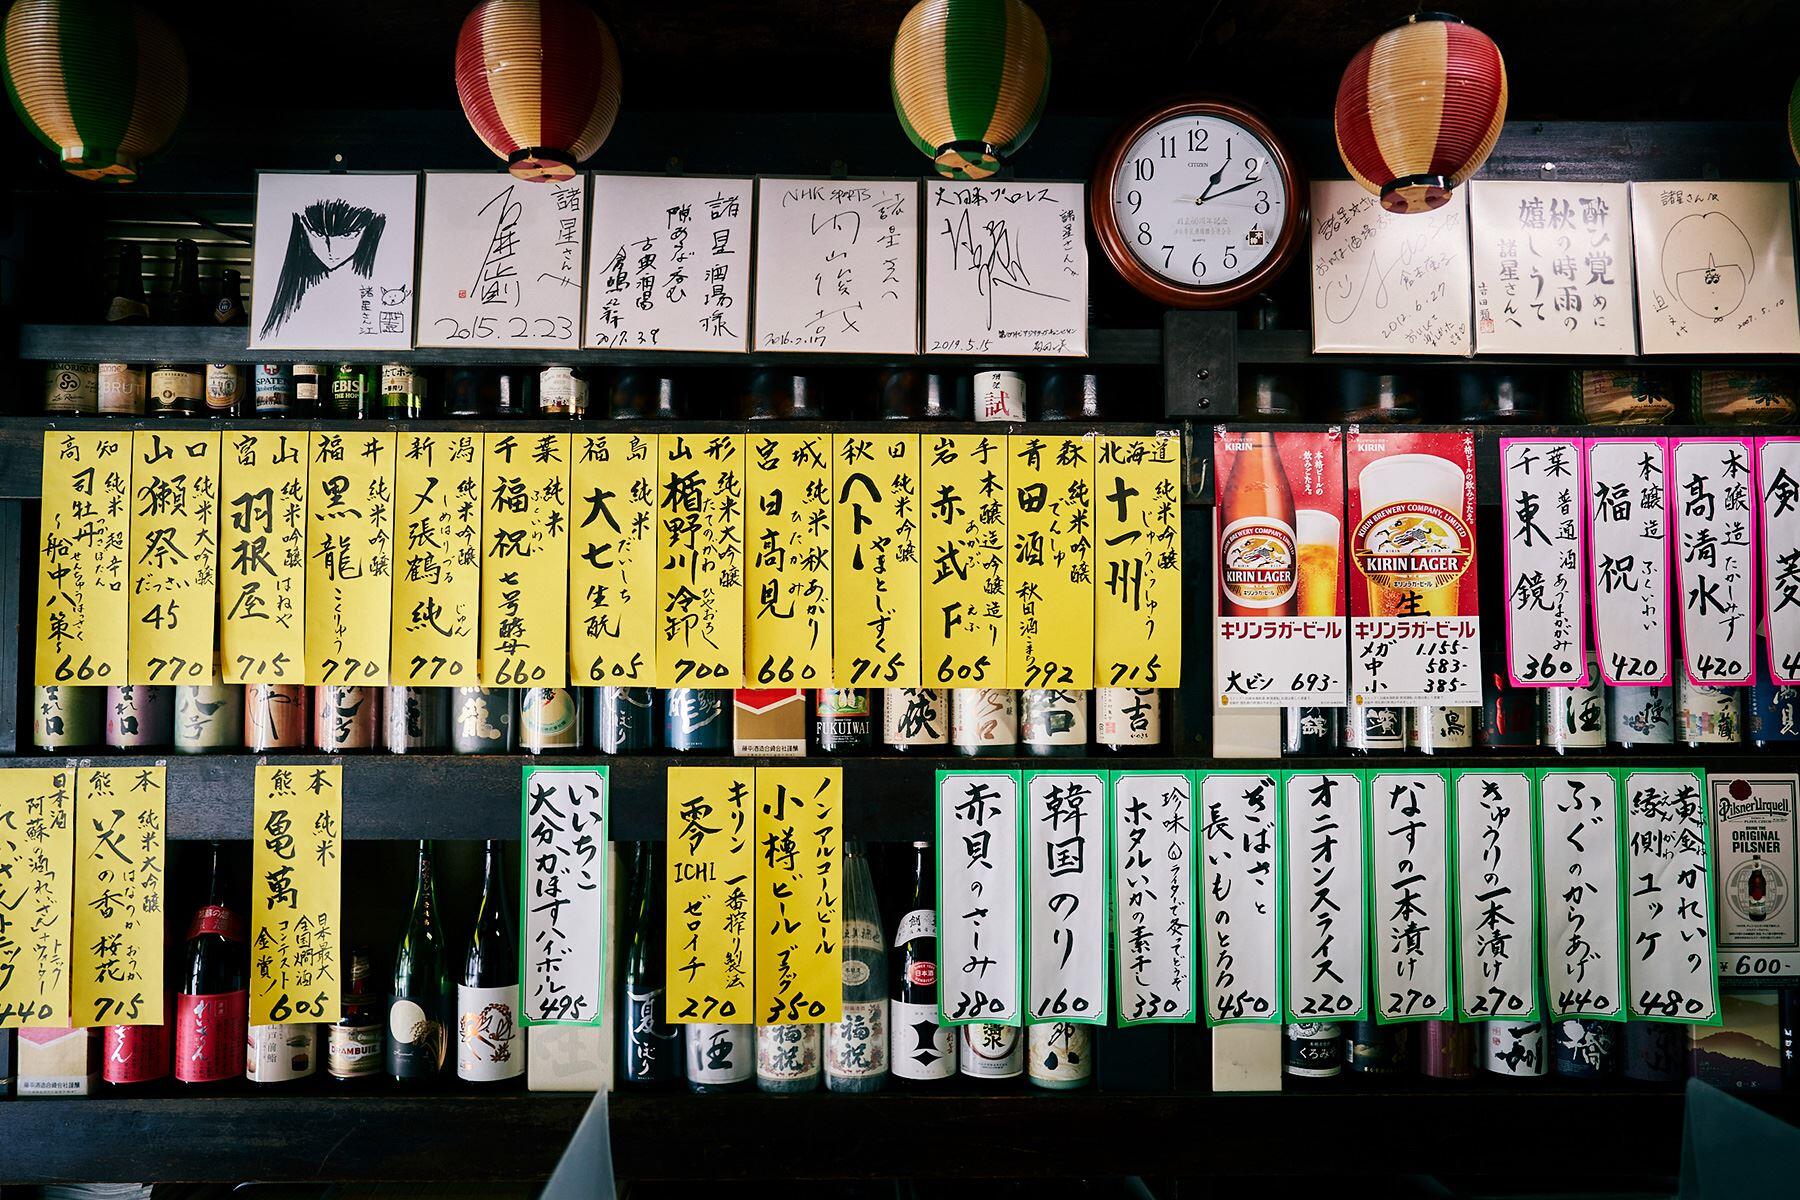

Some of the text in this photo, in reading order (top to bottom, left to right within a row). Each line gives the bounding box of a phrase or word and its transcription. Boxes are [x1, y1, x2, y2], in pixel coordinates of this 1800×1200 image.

[1160, 136, 1176, 158] 11
[1187, 128, 1209, 152] 12
[1226, 138, 1232, 160] 1
[1134, 158, 1154, 181] 10
[1245, 158, 1258, 181] 2
[1128, 190, 1142, 215] 9
[1255, 191, 1270, 214] 3
[1137, 222, 1152, 245] 8
[1161, 245, 1174, 268] 7
[1192, 253, 1206, 277] 6
[1223, 246, 1238, 269] 5
[984, 390, 1010, 418] 試
[1225, 443, 1253, 452] KIRIN
[1357, 443, 1386, 453] KIRIN
[1367, 557, 1459, 571] KIRIN LAGER
[1227, 571, 1291, 583] KIRIN LAGER
[142, 603, 179, 629] 45
[1395, 589, 1432, 620] 生
[1221, 621, 1343, 640] キリンラガービール
[1355, 621, 1476, 640] キリンラガービール
[55, 655, 111, 681] 660
[148, 657, 203, 681] 770
[237, 652, 290, 679] 715
[322, 658, 379, 681] 770
[410, 656, 463, 679] 770
[496, 658, 545, 685] 660
[590, 653, 643, 681] 605
[675, 659, 729, 684] 700
[758, 655, 816, 684] 660
[850, 652, 905, 684] 715
[938, 655, 990, 682] 605
[1025, 662, 1073, 688] 792
[1110, 654, 1161, 685] 715
[1363, 656, 1385, 676] 中
[1521, 653, 1575, 681] 360
[1609, 652, 1660, 681] 420
[1697, 654, 1744, 681] 420
[1365, 680, 1387, 693] 小
[1719, 797, 1756, 822] Pilsner
[1732, 830, 1780, 841] ORIGINAL
[1732, 841, 1780, 853] PILSNER
[674, 862, 716, 883] ICHI
[1309, 776, 1343, 983] オニオンスライス
[1388, 782, 1430, 981] なすの一本漬け
[1475, 780, 1515, 982] きゅうりの一本漬け
[1558, 780, 1603, 983] ふぐのからあげ
[94, 994, 144, 1022] 715
[267, 991, 331, 1024] 605
[538, 993, 588, 1021] 495
[679, 996, 736, 1019] 270
[767, 992, 825, 1026] 350
[950, 991, 1005, 1020] 380
[1035, 988, 1092, 1018] 160
[1130, 992, 1180, 1020] 330
[1218, 990, 1272, 1019] 450
[1301, 994, 1355, 1015] 220
[1388, 989, 1439, 1015] 270
[1469, 986, 1526, 1016] 270
[1558, 989, 1612, 1014] 440
[1637, 990, 1703, 1017] 480
